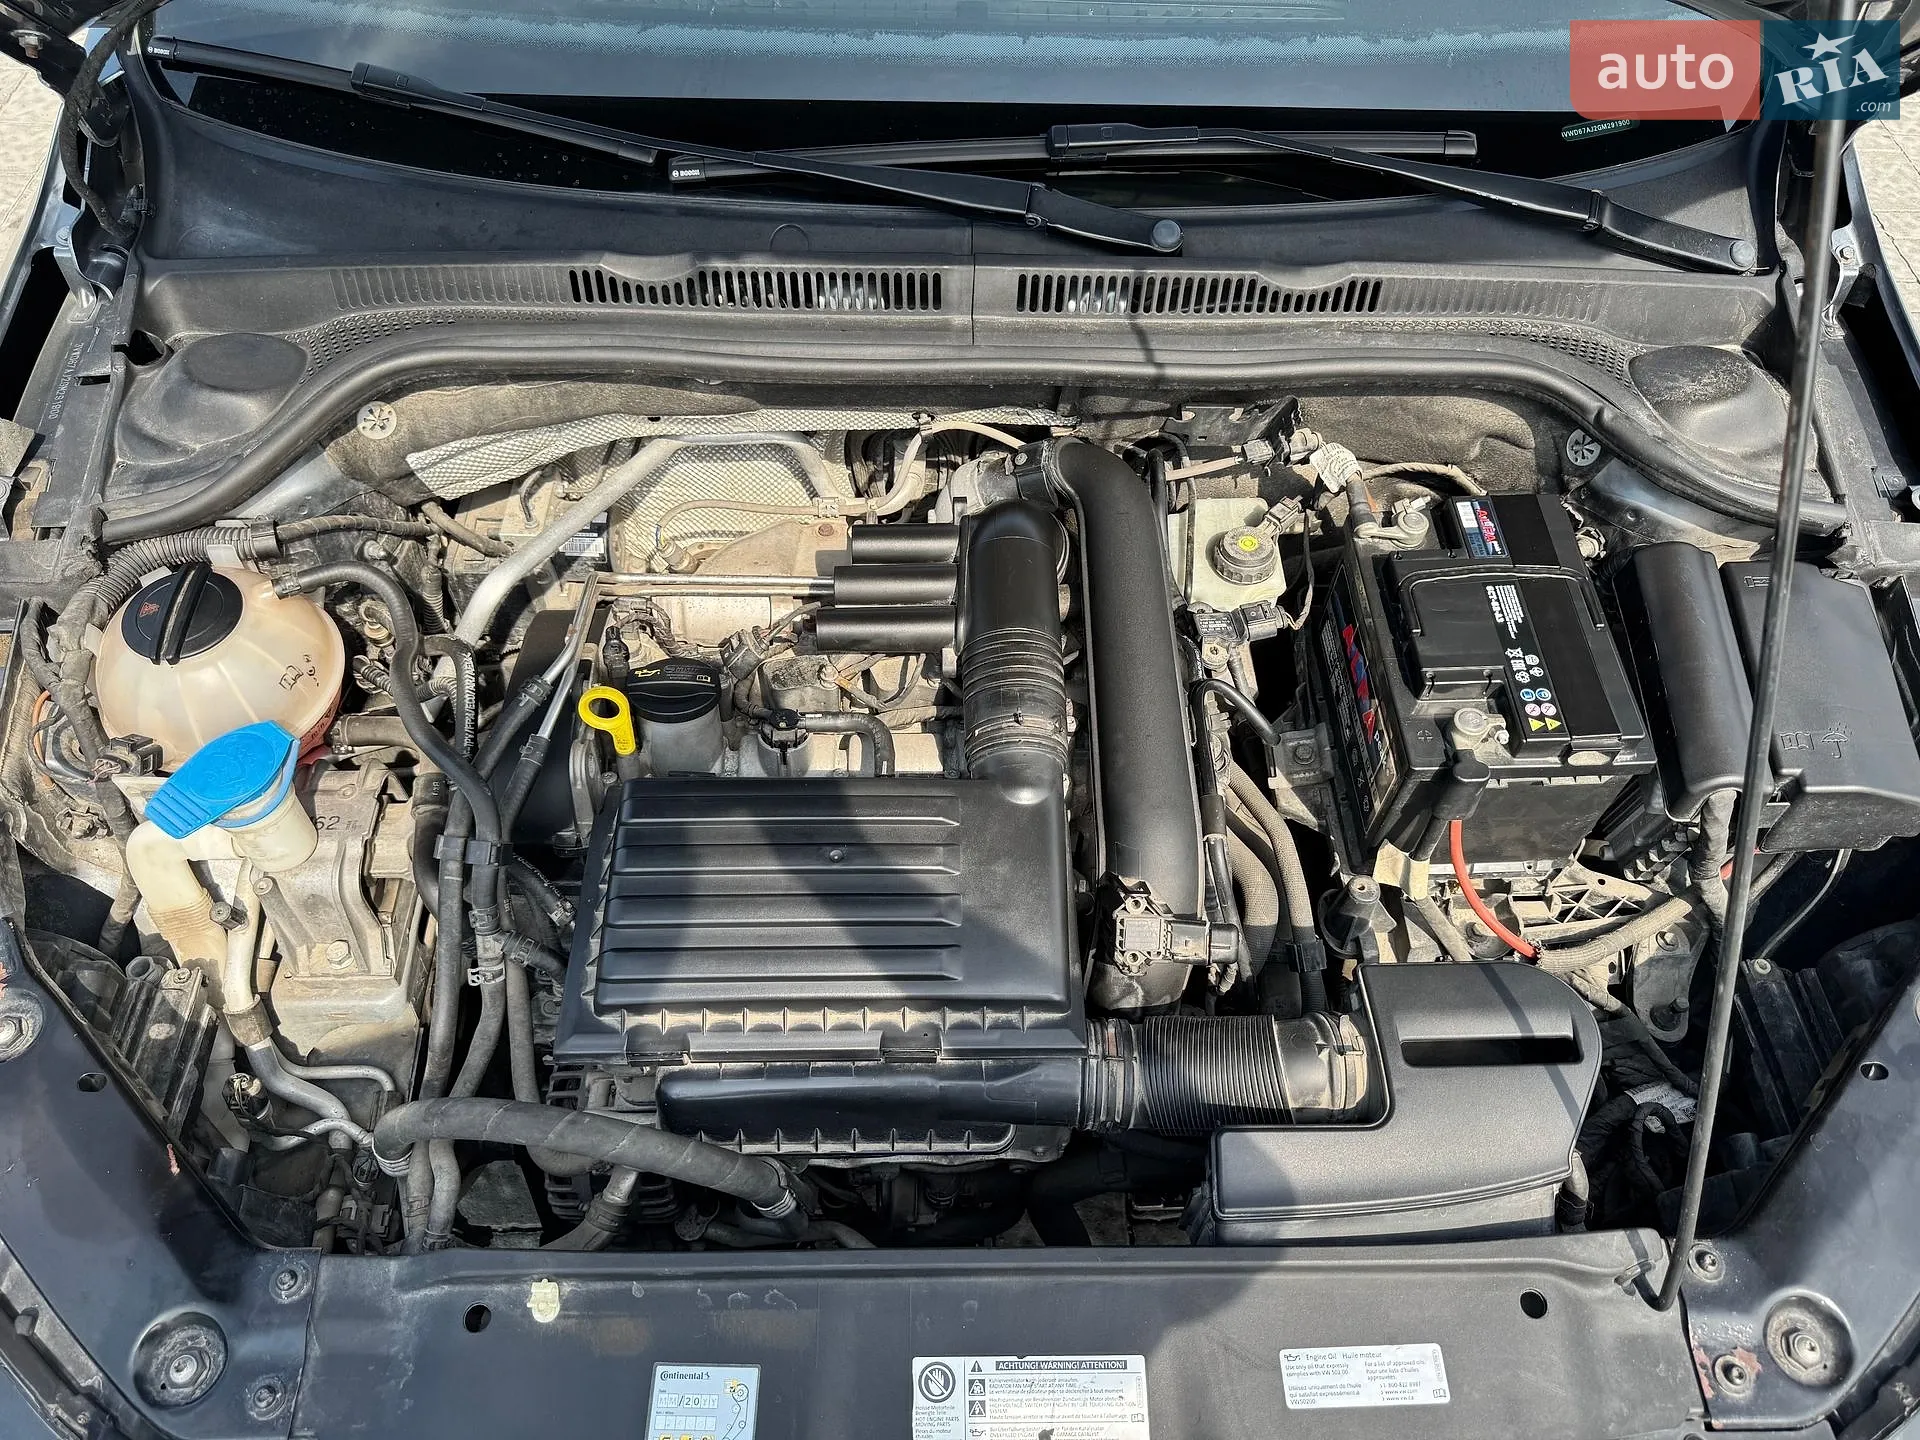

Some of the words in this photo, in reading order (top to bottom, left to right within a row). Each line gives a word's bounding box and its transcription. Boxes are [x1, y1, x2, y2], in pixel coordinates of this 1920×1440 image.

[998, 1361, 1039, 1370] ACHTUNG!
[1040, 1361, 1080, 1370] WARNING!
[1081, 1360, 1125, 1370] ATTENTION!
